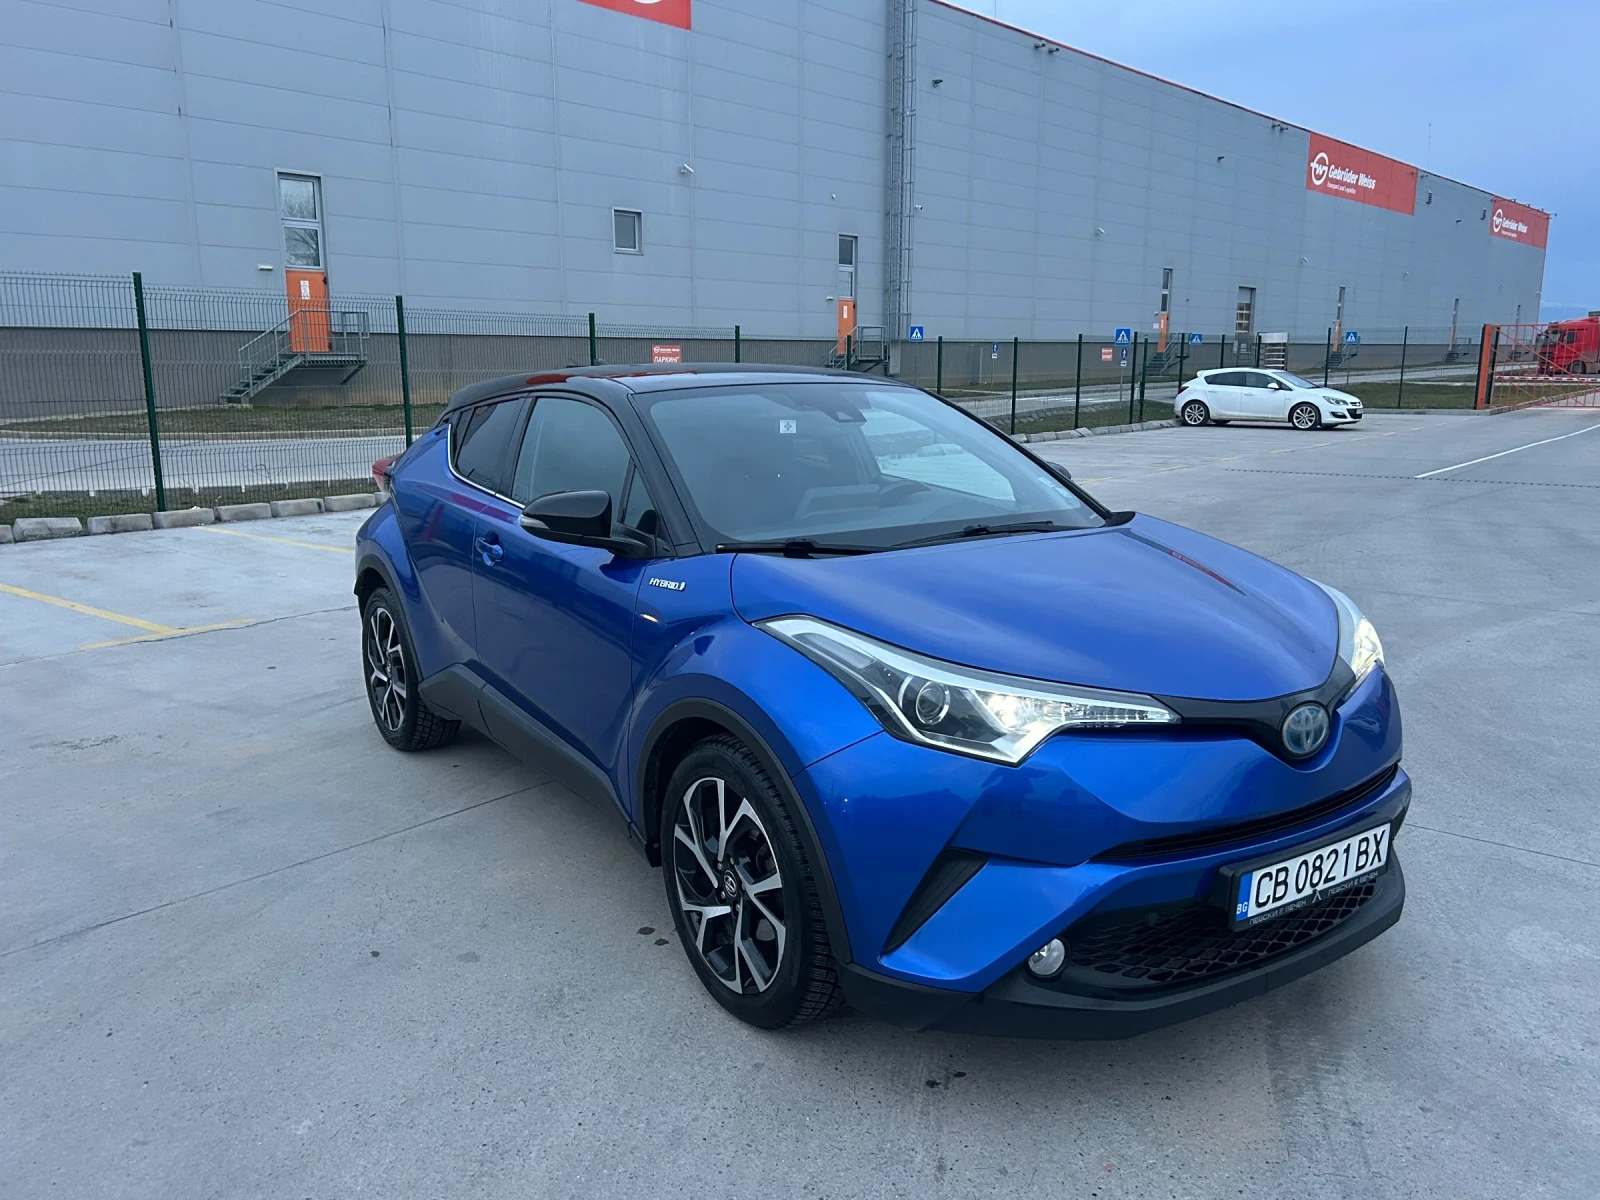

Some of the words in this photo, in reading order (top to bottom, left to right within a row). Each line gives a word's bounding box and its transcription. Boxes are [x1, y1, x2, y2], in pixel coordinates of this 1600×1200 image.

[1328, 164, 1358, 184] Gebrüder
[1358, 173, 1376, 189] Weiss
[649, 577, 679, 590] HYBRID
[1254, 866, 1290, 909] CB
[1294, 843, 1352, 895] 0821
[1354, 829, 1386, 873] BX
[1236, 901, 1249, 915] BG
